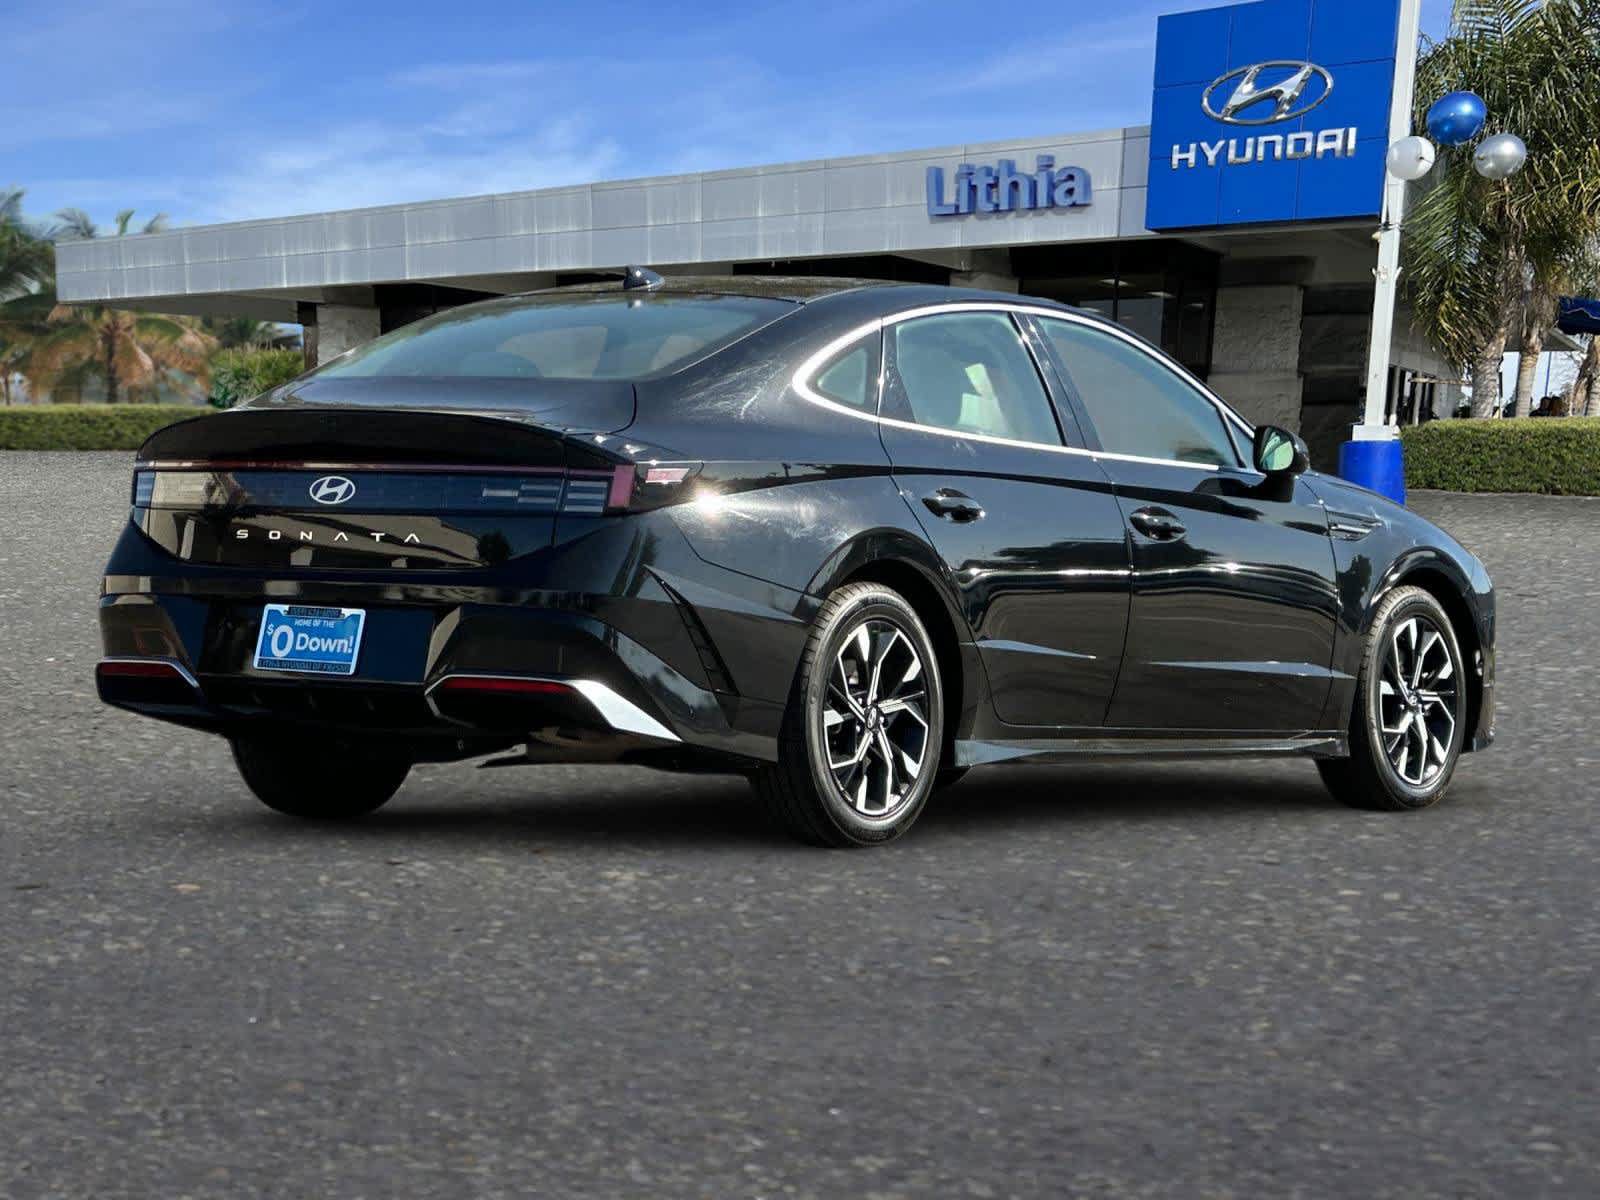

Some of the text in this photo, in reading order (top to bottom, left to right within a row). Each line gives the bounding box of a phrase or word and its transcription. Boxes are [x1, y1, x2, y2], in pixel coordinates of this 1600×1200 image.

[1171, 127, 1358, 169] HYUNDAI
[926, 154, 1093, 215] Lithia
[236, 529, 421, 544] SONATA
[294, 618, 335, 629] HOME OF THE
[295, 632, 354, 654] Down!
